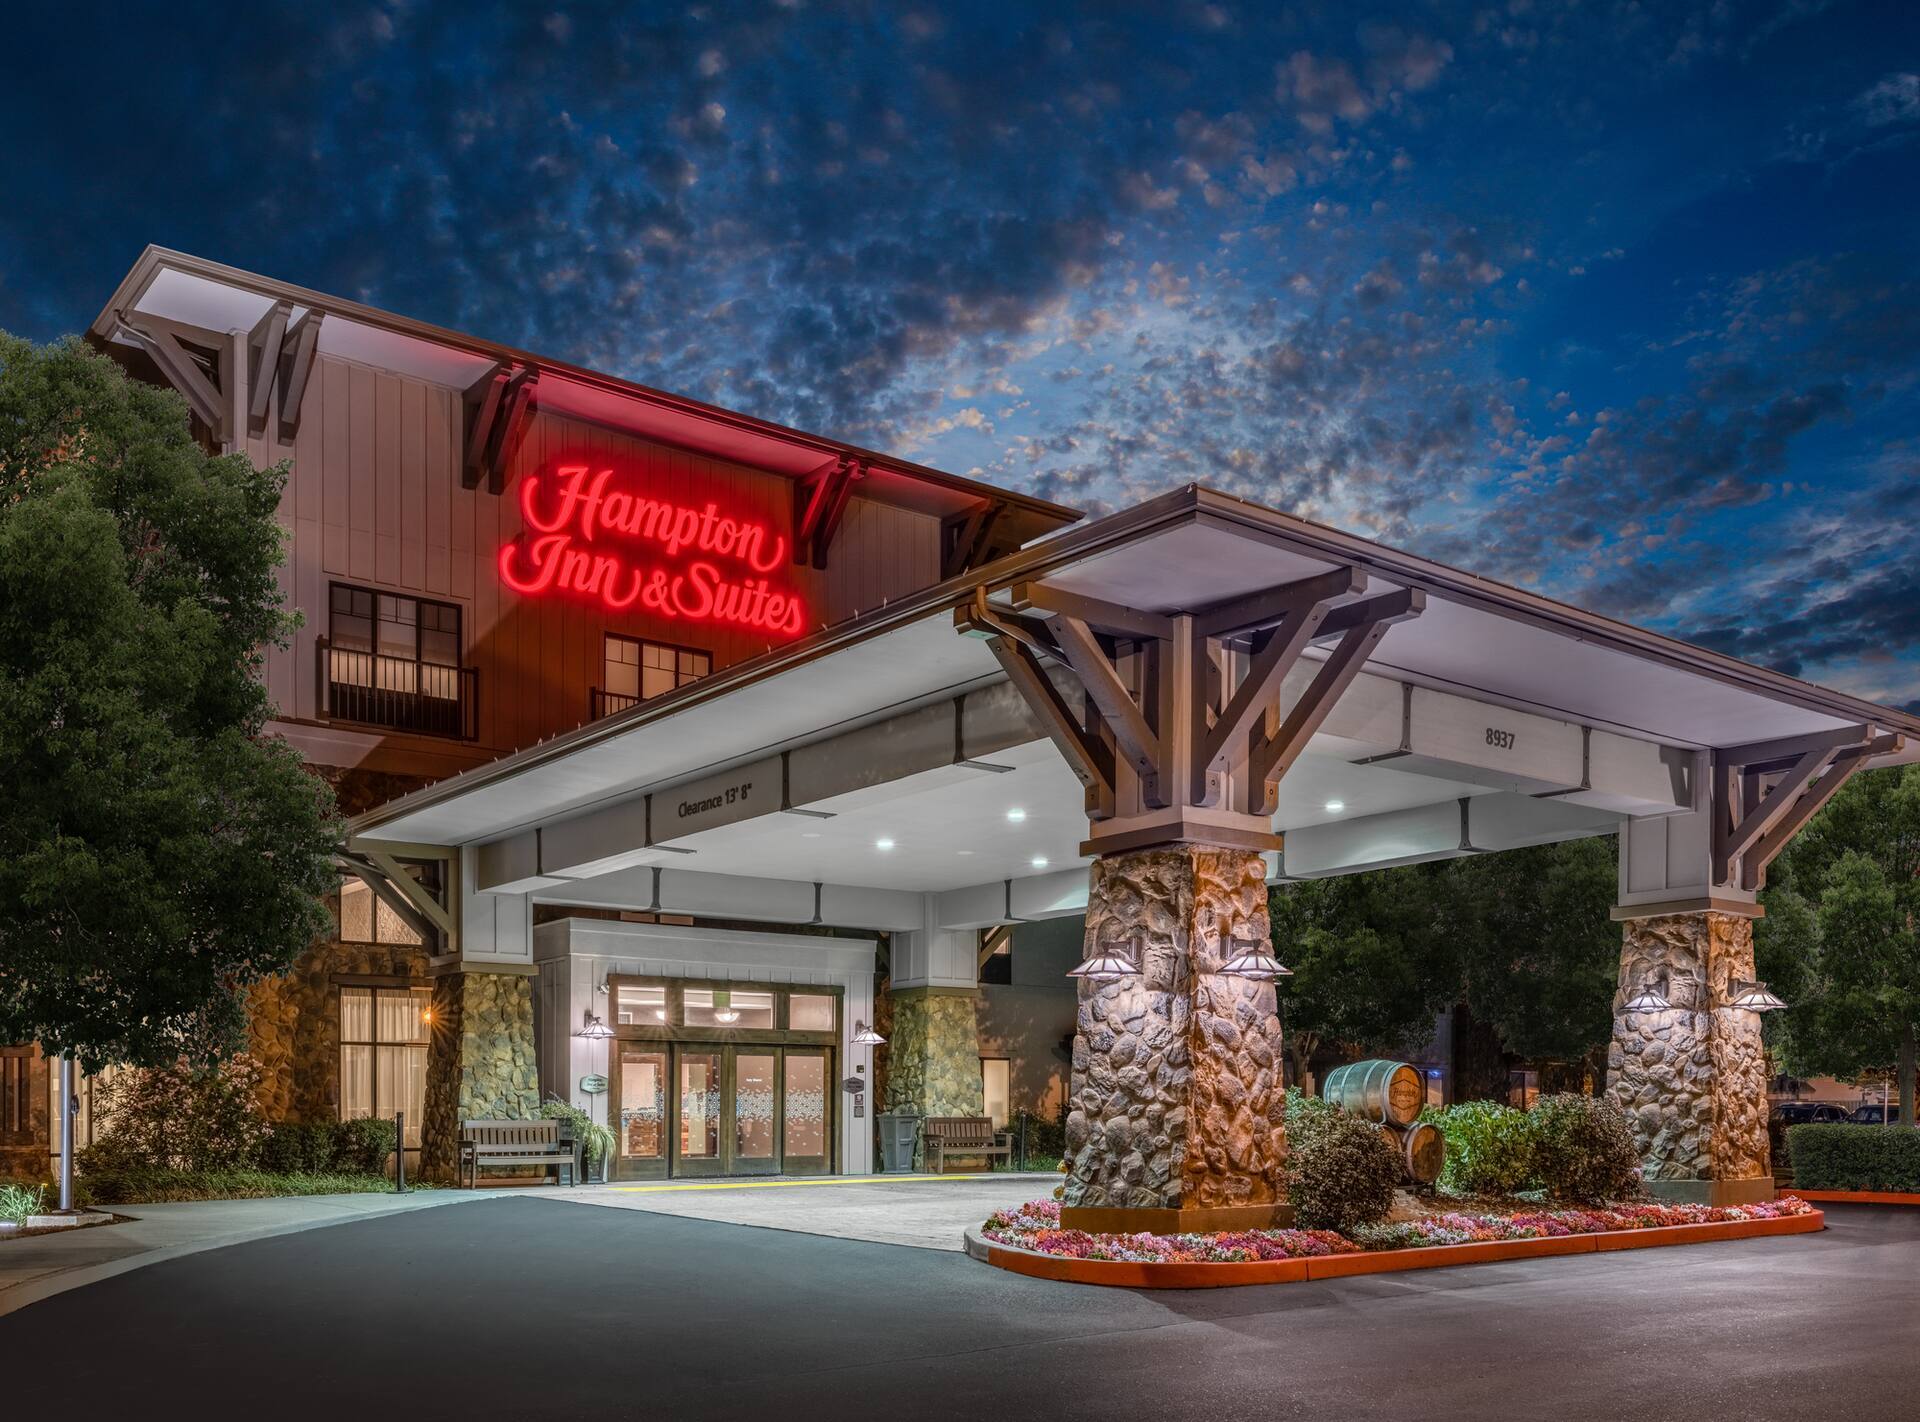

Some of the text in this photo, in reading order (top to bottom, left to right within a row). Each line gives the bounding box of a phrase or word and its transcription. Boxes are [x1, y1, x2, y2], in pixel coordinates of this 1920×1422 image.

[521, 466, 784, 572] Hampton
[502, 534, 802, 634] Inn & Suites
[1485, 727, 1516, 750] 8937
[678, 795, 723, 818] Clearance
